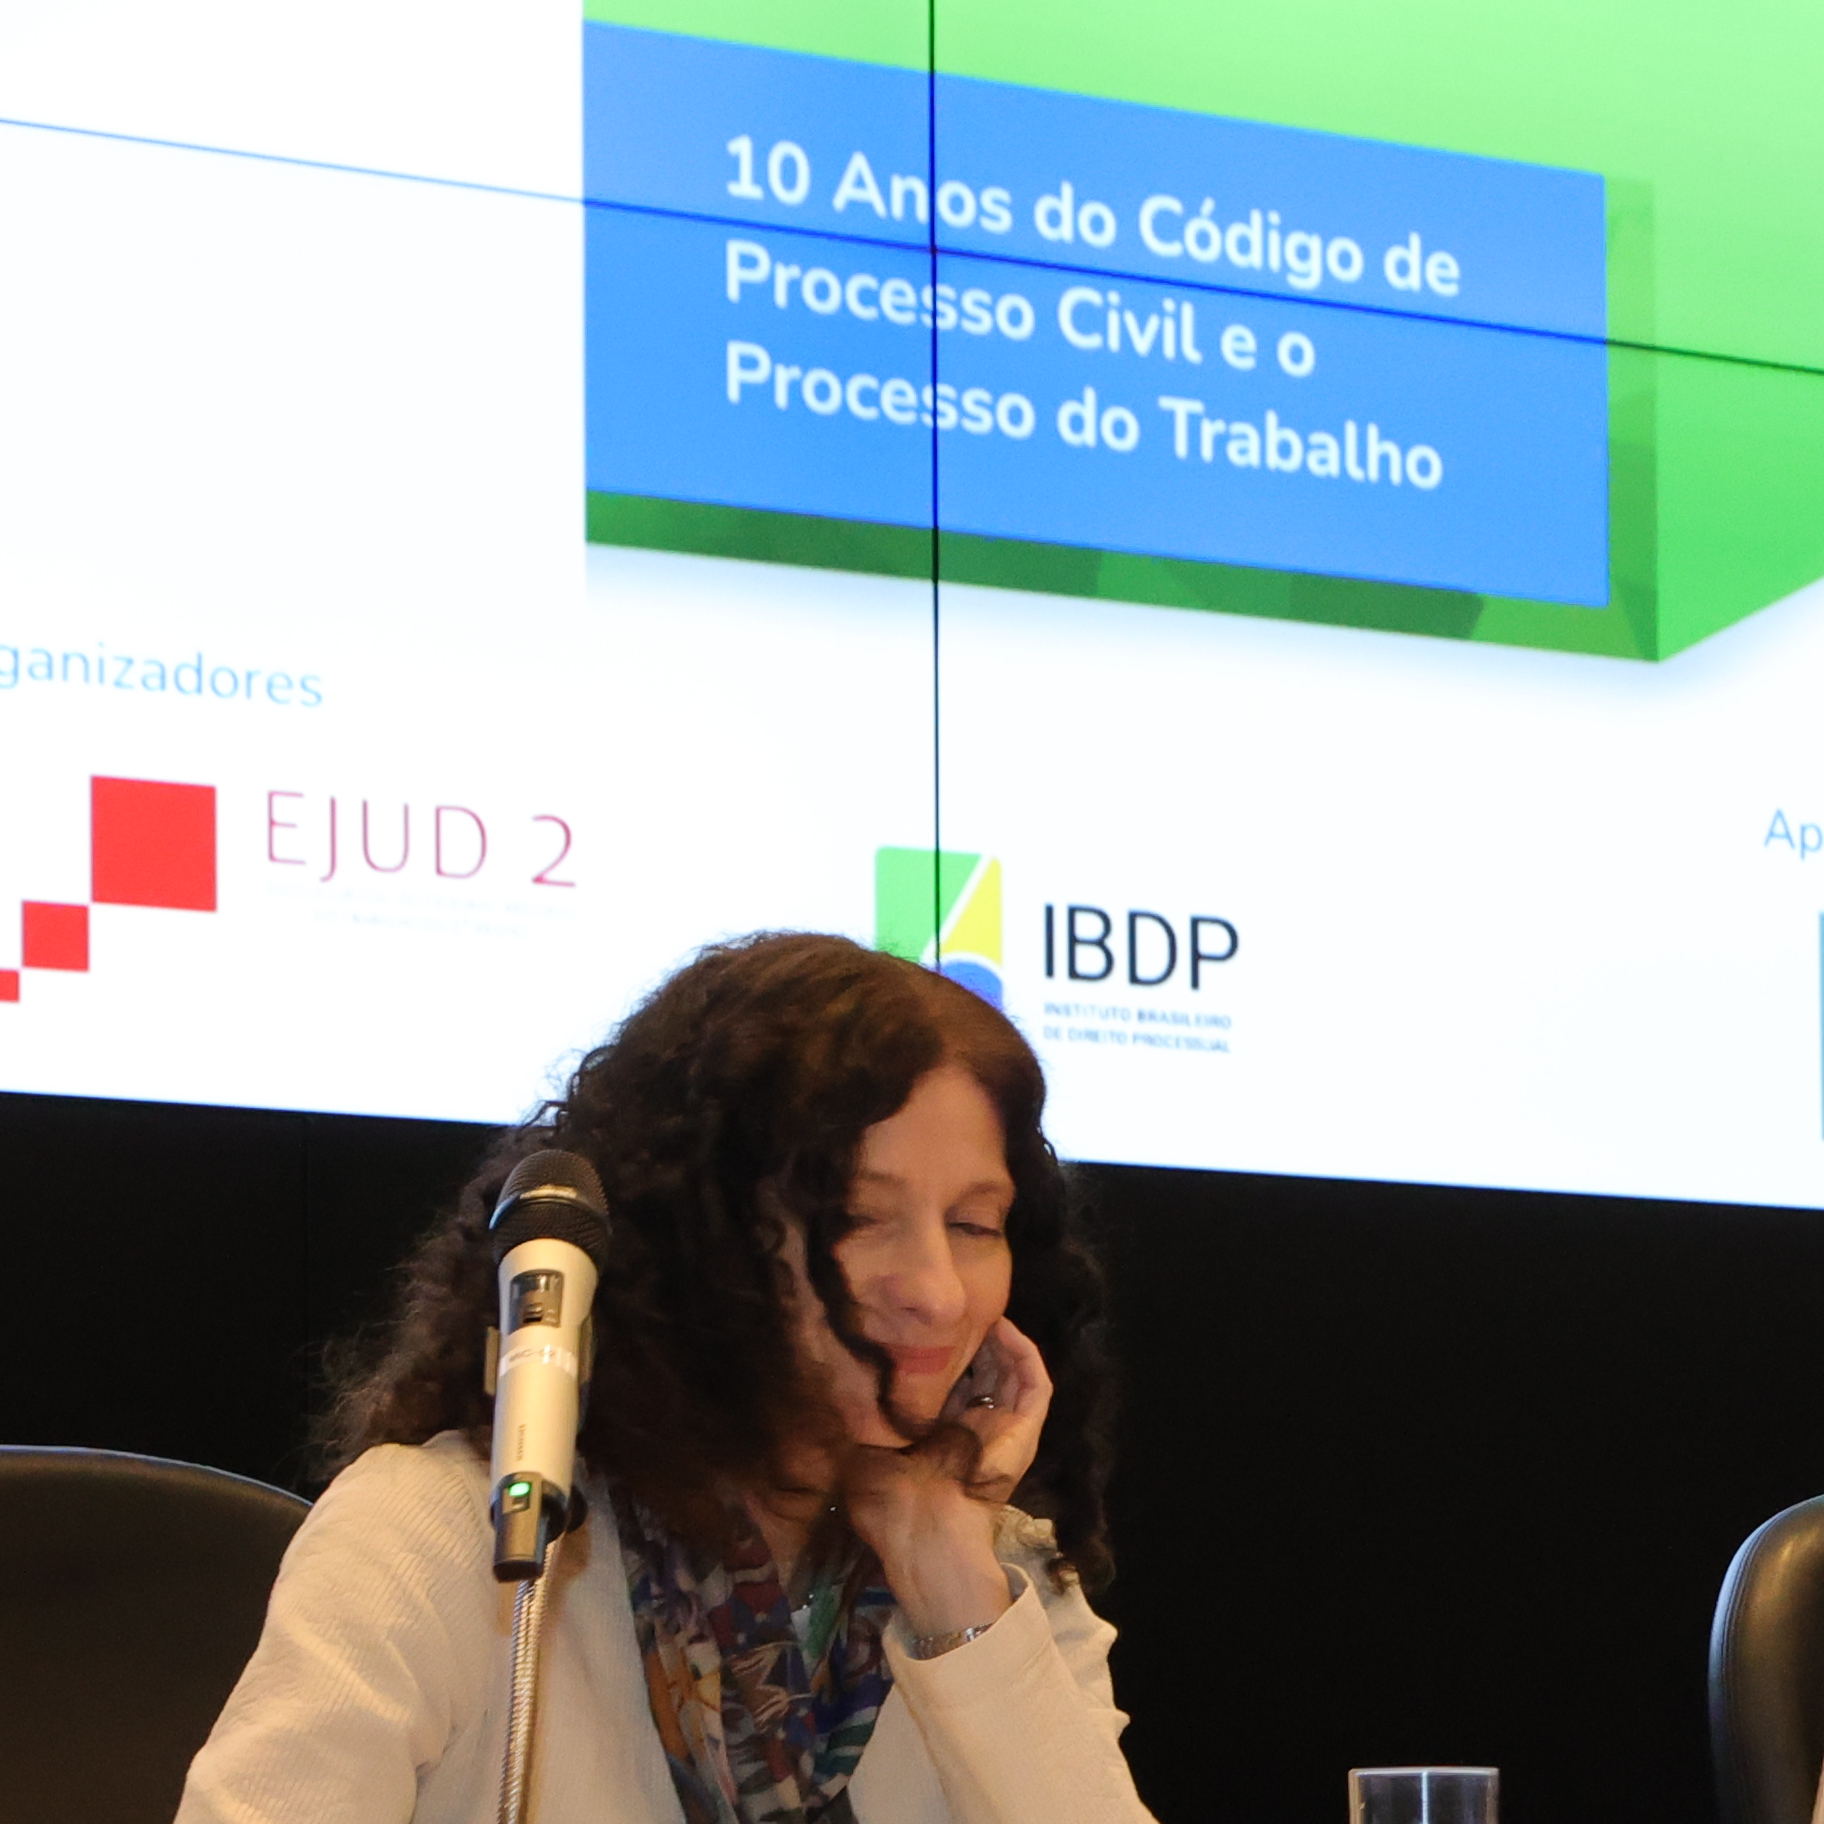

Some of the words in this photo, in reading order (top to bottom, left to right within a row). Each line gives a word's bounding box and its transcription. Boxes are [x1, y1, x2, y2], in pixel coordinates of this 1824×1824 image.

[726, 135, 811, 205] 10
[833, 151, 1013, 234] Anos
[1034, 180, 1117, 247] do
[1139, 196, 1364, 290] Código
[1384, 231, 1460, 297] de
[726, 239, 1035, 341] Processo
[1058, 286, 1202, 364] Civil
[1220, 324, 1257, 370] e
[1277, 331, 1315, 377] o
[726, 340, 1036, 441] Processo
[1056, 386, 1139, 452] do
[1158, 395, 1443, 490] Trabalho
[0, 641, 323, 707] ganizadores
[267, 790, 488, 882] EJUD
[530, 814, 577, 887] 2
[1043, 903, 1240, 991] IBDP
[1043, 1001, 1131, 1022] INSTITUTO
[1137, 1008, 1232, 1030] BRASILEIRO
[1043, 1025, 1062, 1041] DE
[1068, 1027, 1127, 1045] DIREITO
[1132, 1032, 1231, 1054] PROCESSUAL
